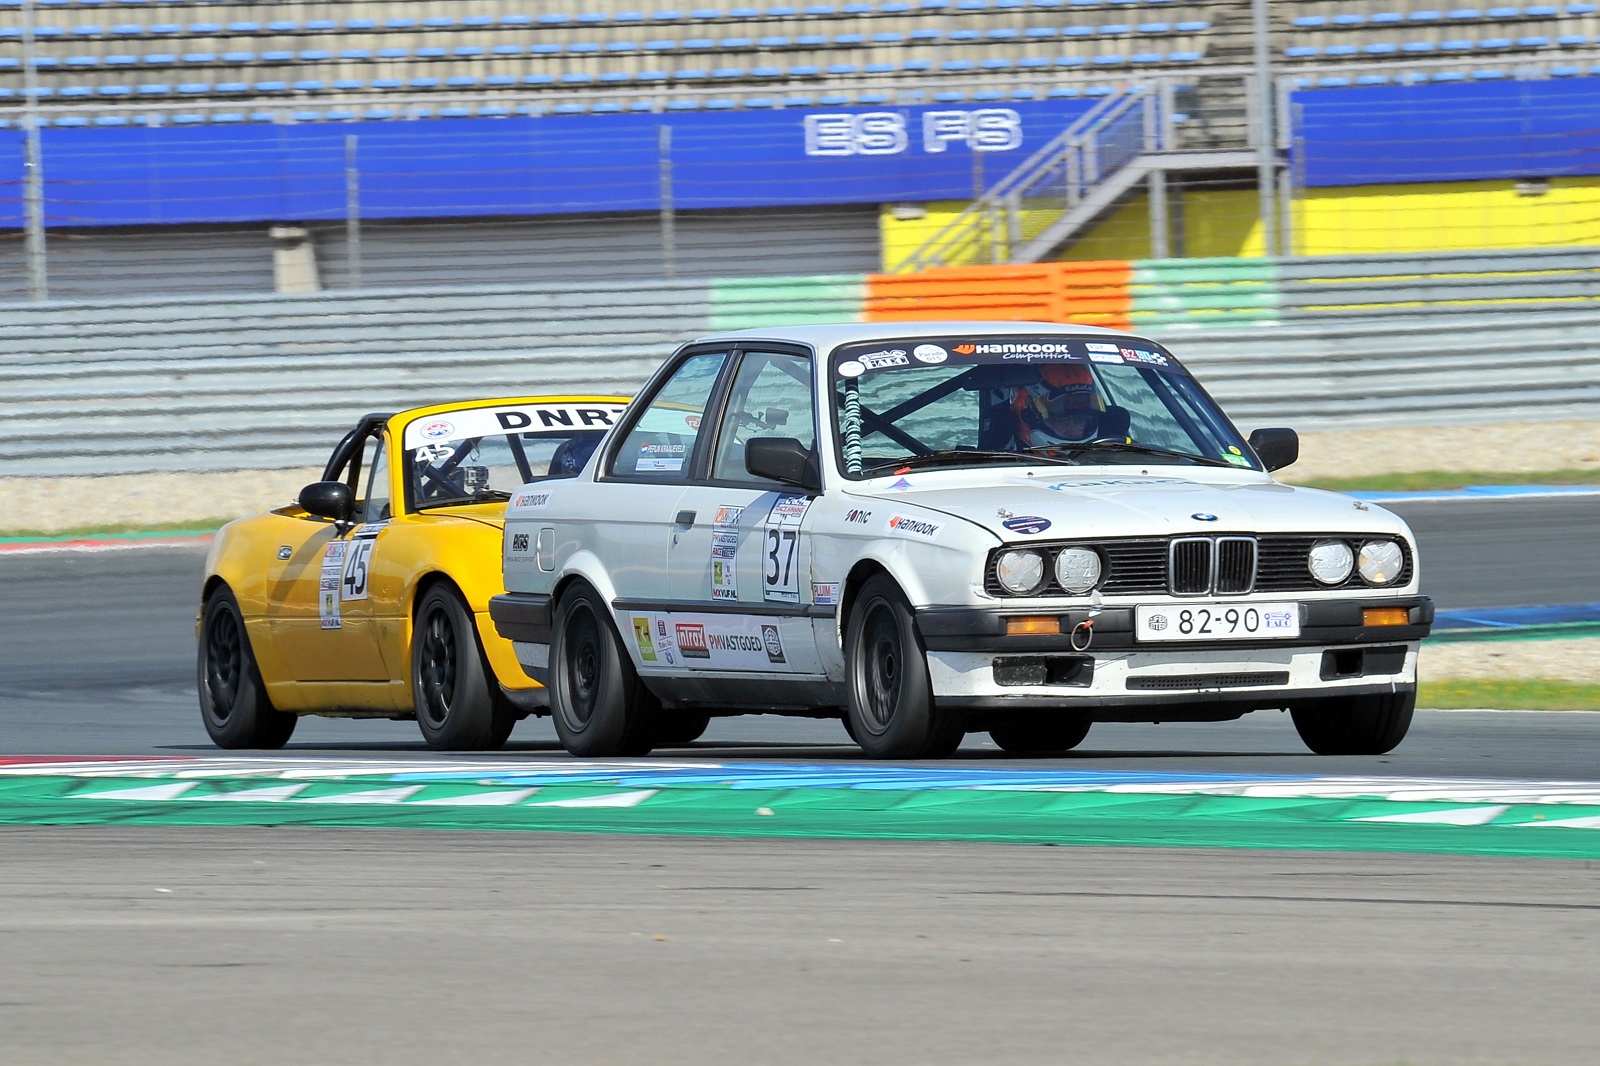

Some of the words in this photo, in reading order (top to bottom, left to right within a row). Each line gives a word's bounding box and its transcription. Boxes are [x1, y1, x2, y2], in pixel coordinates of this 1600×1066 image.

[804, 112, 908, 157] ES
[922, 108, 1023, 153] FS
[975, 343, 1069, 354] HANKOOK
[415, 442, 456, 463] 45
[896, 517, 940, 537] HANKOOK
[343, 543, 372, 595] 45
[766, 528, 797, 586] 37
[1178, 607, 1260, 635] 82-90
